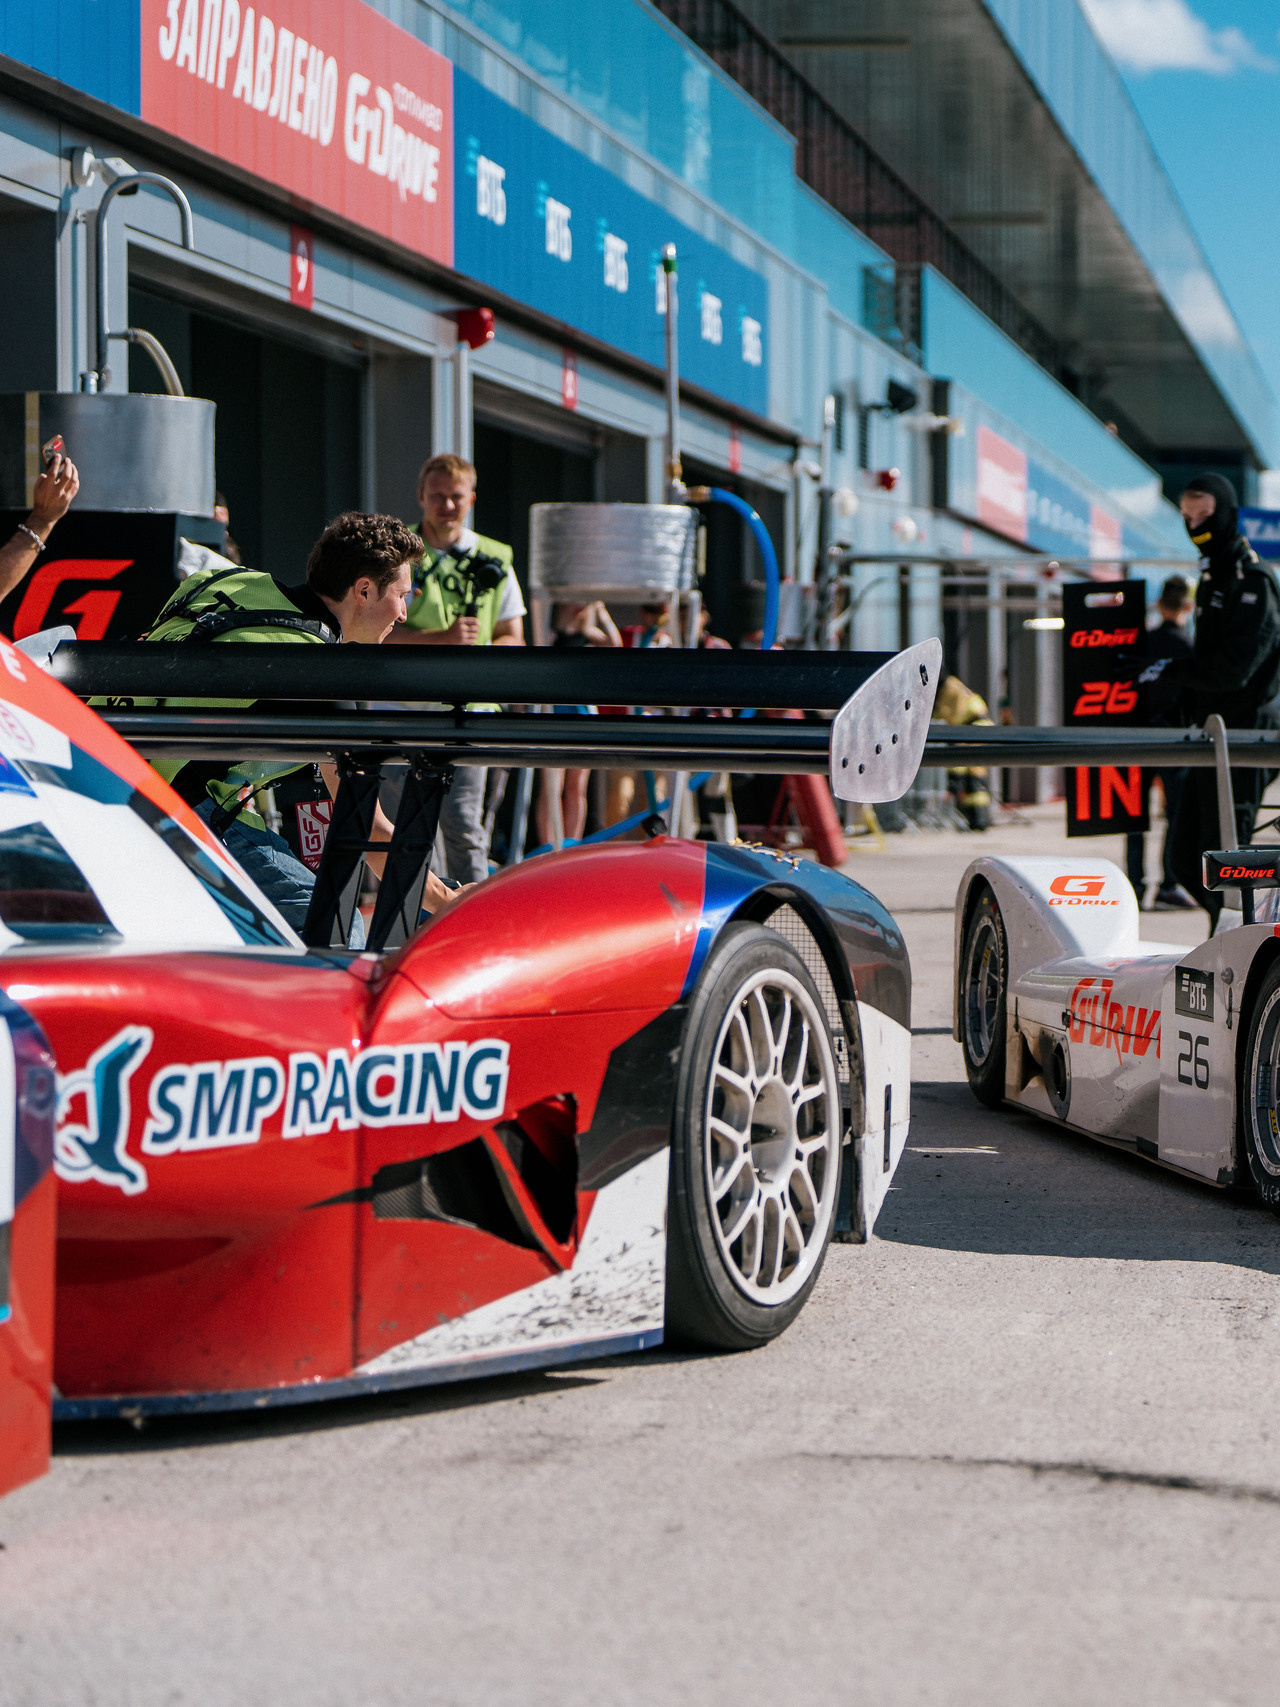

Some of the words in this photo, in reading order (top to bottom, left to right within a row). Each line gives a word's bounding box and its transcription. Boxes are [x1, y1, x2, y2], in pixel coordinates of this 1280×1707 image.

[159, 0, 338, 146] ЗАПРАВЛЕНО
[296, 239, 309, 292] 9
[1073, 680, 1138, 716] 26
[1076, 765, 1141, 820] IN
[1189, 981, 1207, 1011] ВТБ
[1178, 1030, 1209, 1090] 26
[147, 1061, 282, 1150] SMP
[287, 1045, 506, 1138] RACING
